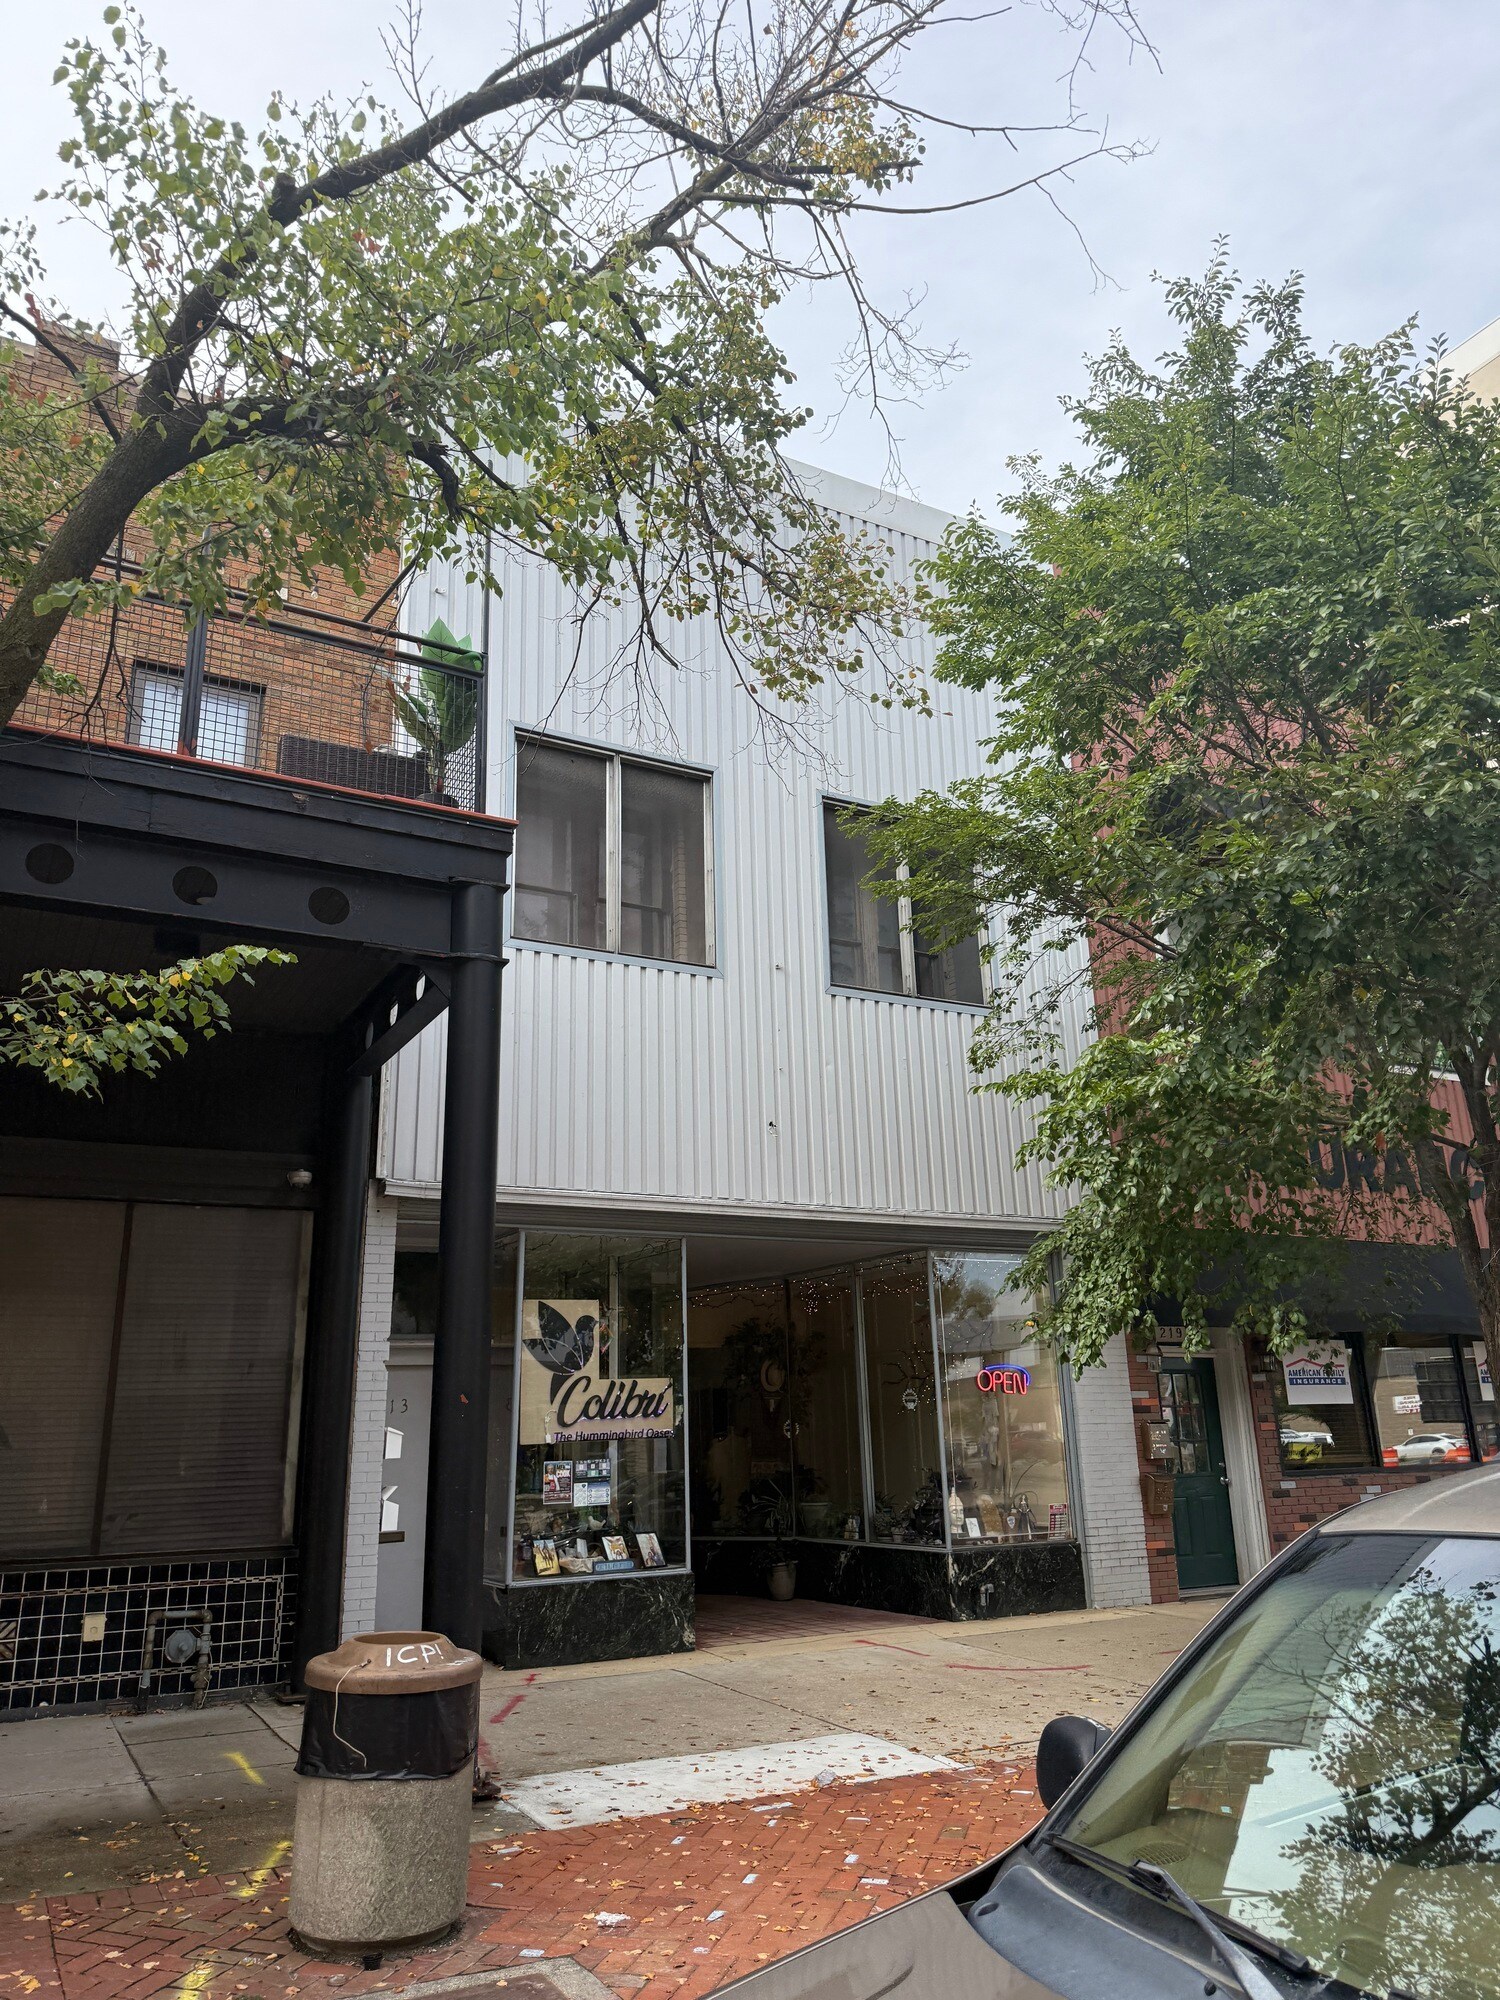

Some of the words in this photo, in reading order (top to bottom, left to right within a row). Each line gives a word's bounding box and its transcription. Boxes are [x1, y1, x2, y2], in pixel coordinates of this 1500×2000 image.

[1158, 1326, 1183, 1339] 219
[1288, 1369, 1321, 1377] AMERICAN
[1322, 1369, 1344, 1377] FILY
[977, 1369, 1027, 1395] OPEN
[556, 1375, 673, 1428] Colibri
[554, 1432, 573, 1443] The
[575, 1428, 645, 1442] Hummingbird
